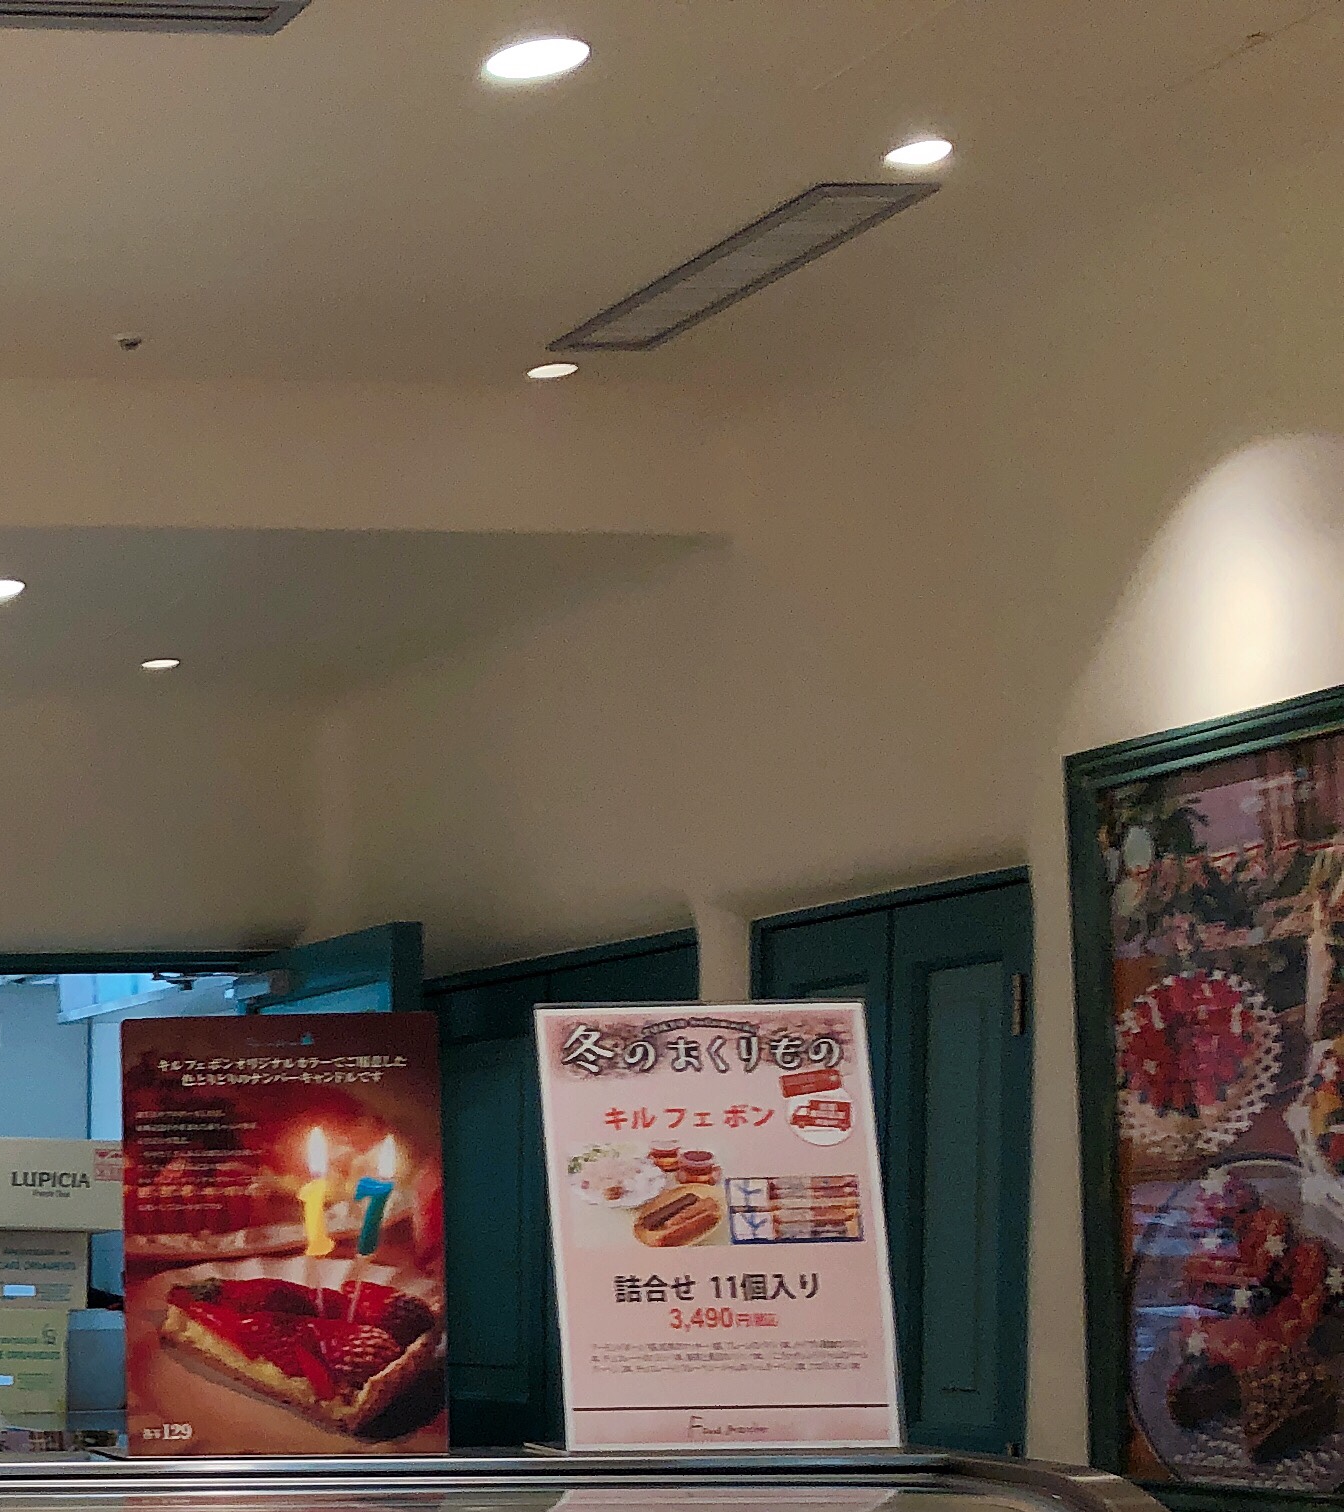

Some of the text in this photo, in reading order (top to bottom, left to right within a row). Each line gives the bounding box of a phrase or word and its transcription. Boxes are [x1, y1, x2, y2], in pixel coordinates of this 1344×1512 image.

[11, 1171, 91, 1189] LUPICIA
[613, 1272, 821, 1303] 詰合せ 11個入り
